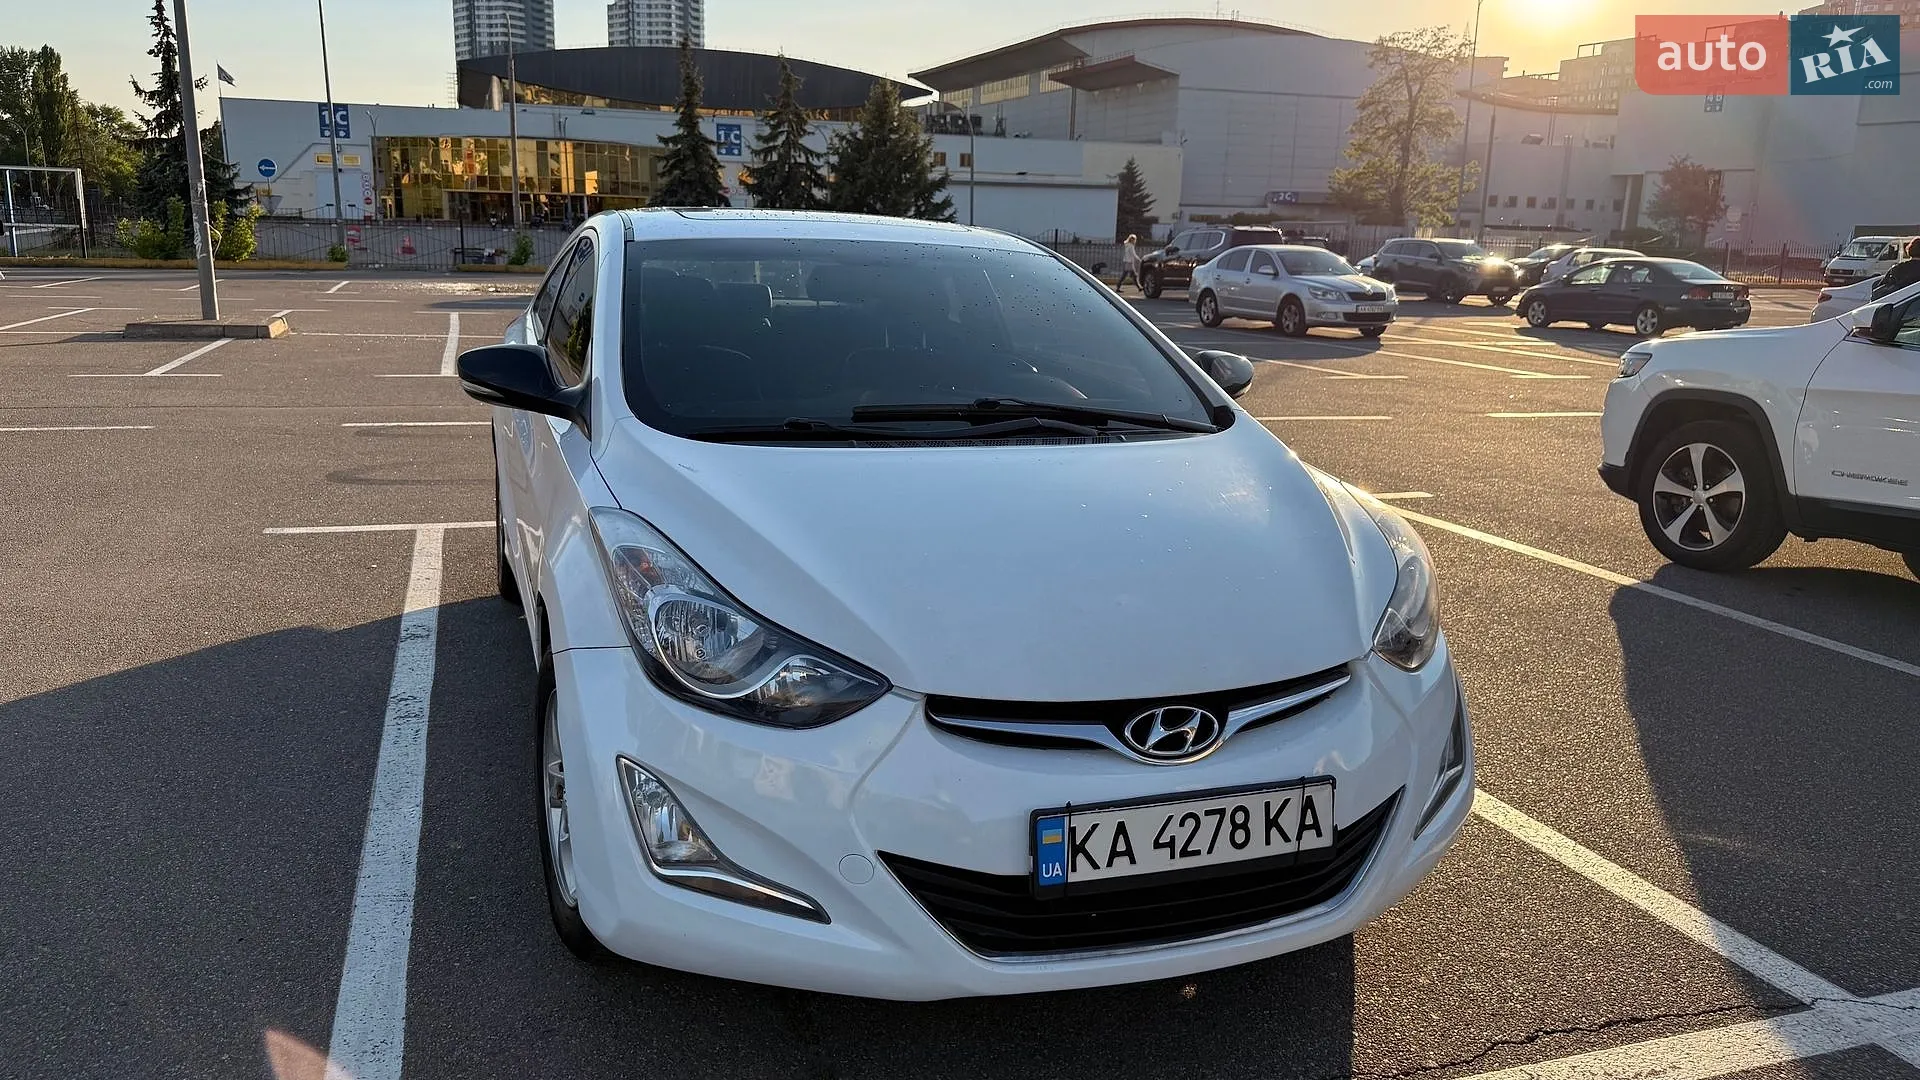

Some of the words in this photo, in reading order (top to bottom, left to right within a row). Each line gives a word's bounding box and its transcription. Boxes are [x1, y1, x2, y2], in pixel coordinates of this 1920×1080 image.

[1070, 820, 1137, 873] KA
[1153, 804, 1251, 860] 4278
[1263, 794, 1323, 846] KA
[1042, 862, 1063, 878] UA
